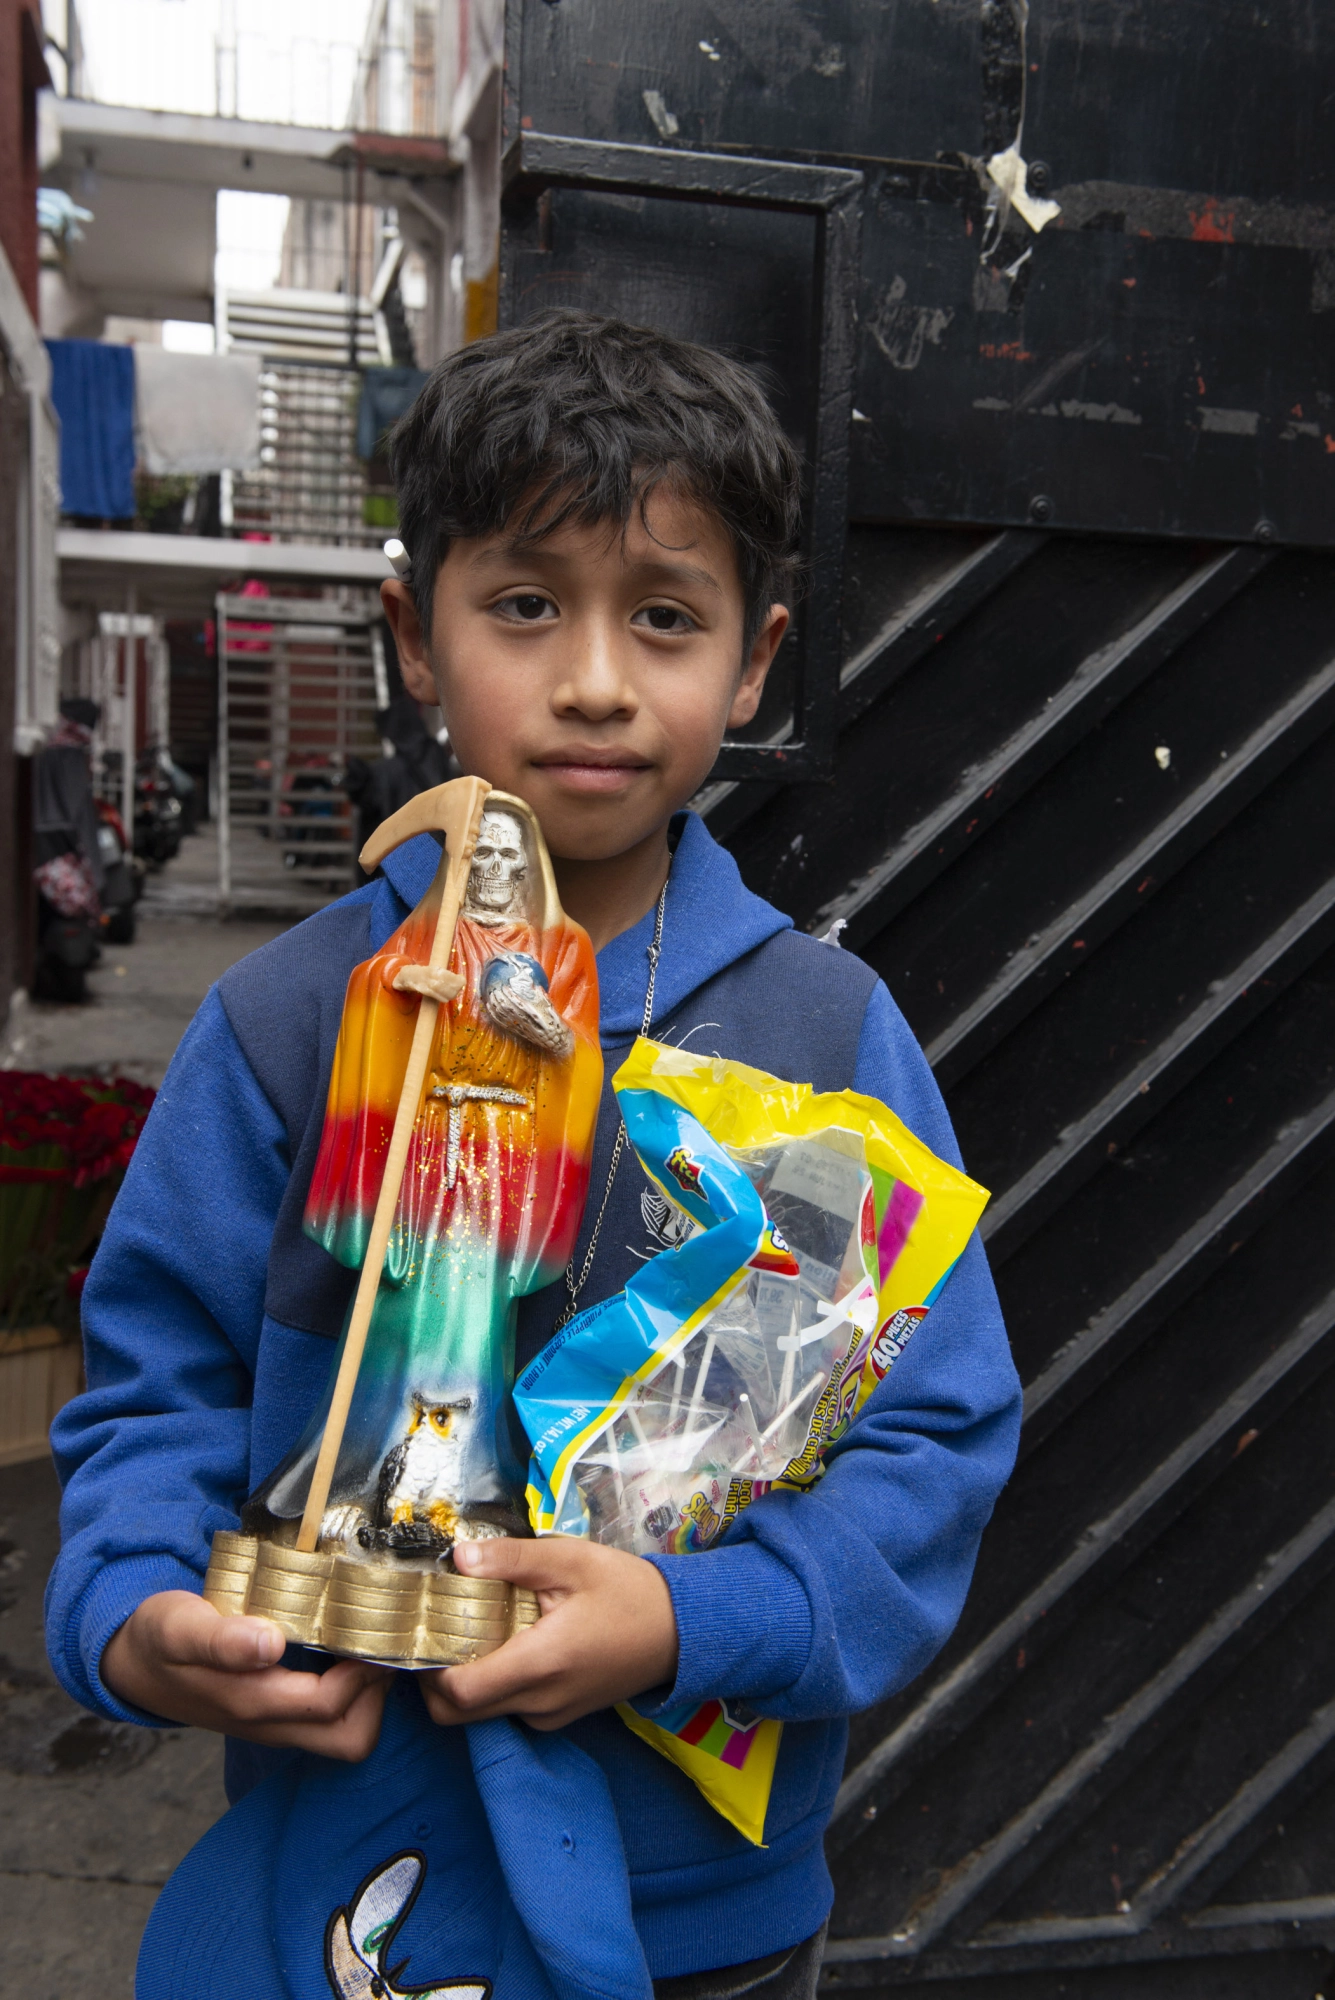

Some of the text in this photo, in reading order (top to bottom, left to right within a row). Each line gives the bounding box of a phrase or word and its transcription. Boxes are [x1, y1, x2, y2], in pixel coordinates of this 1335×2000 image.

[565, 1308, 603, 1340] PINEAPPLE
[896, 1316, 922, 1346] PIEZAS
[871, 1309, 910, 1370] 40 PIECES
[520, 1363, 545, 1391] FLAVOR
[570, 1404, 591, 1422] NET
[809, 1417, 823, 1437] DE
[533, 1440, 546, 1454] OZ
[541, 1425, 563, 1444] 14.1
[724, 1482, 740, 1514] PIÑA
